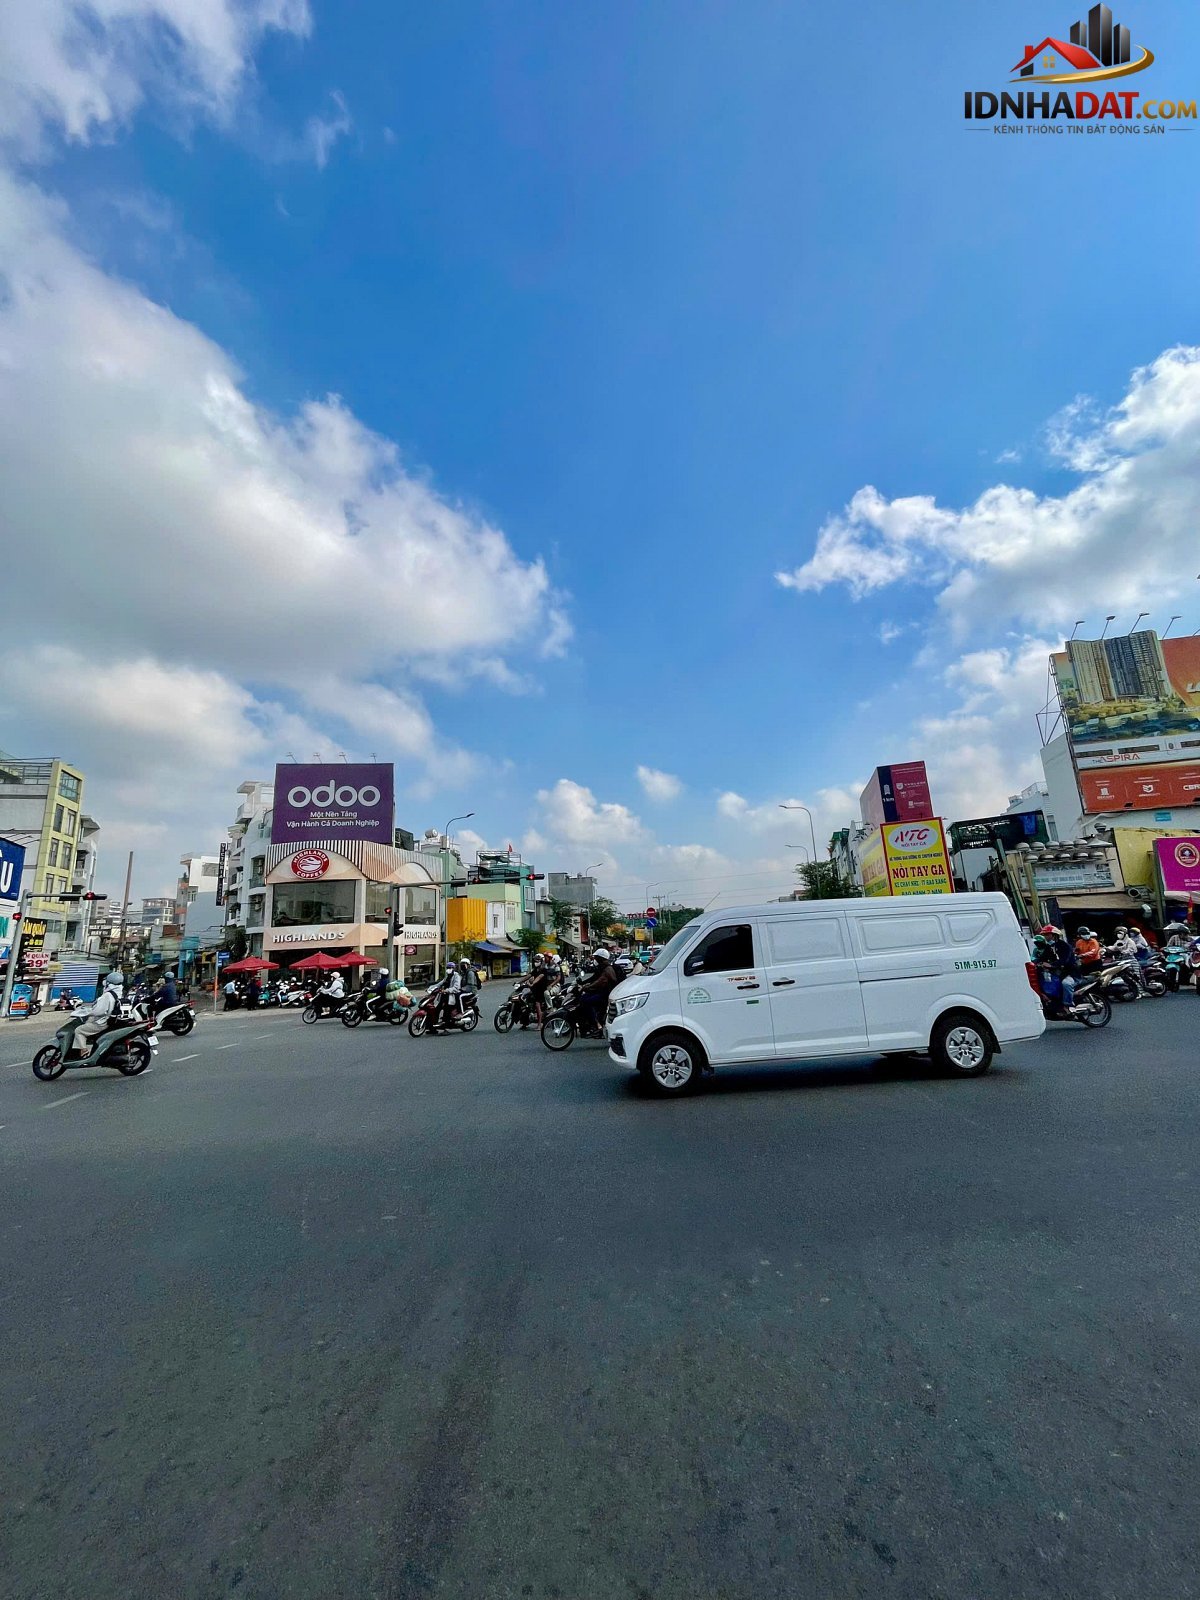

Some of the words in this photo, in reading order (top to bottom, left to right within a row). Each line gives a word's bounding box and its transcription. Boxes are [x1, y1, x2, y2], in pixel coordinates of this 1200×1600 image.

[1100, 754, 1141, 763] ASPIRA
[288, 779, 381, 808] odoo
[310, 811, 324, 819] Một
[325, 810, 340, 818] Nền
[286, 820, 300, 828] Vận
[332, 819, 354, 827] Doanh
[355, 819, 380, 828] Nghiệp
[293, 850, 328, 863] HIGHLANDS
[297, 870, 324, 878] COFFEE
[910, 865, 929, 877] TAY
[931, 864, 945, 876] GA
[272, 931, 346, 944] HIGHLANDS
[404, 931, 438, 940] HIGHLANDS
[954, 959, 997, 970] 51M-915.97
